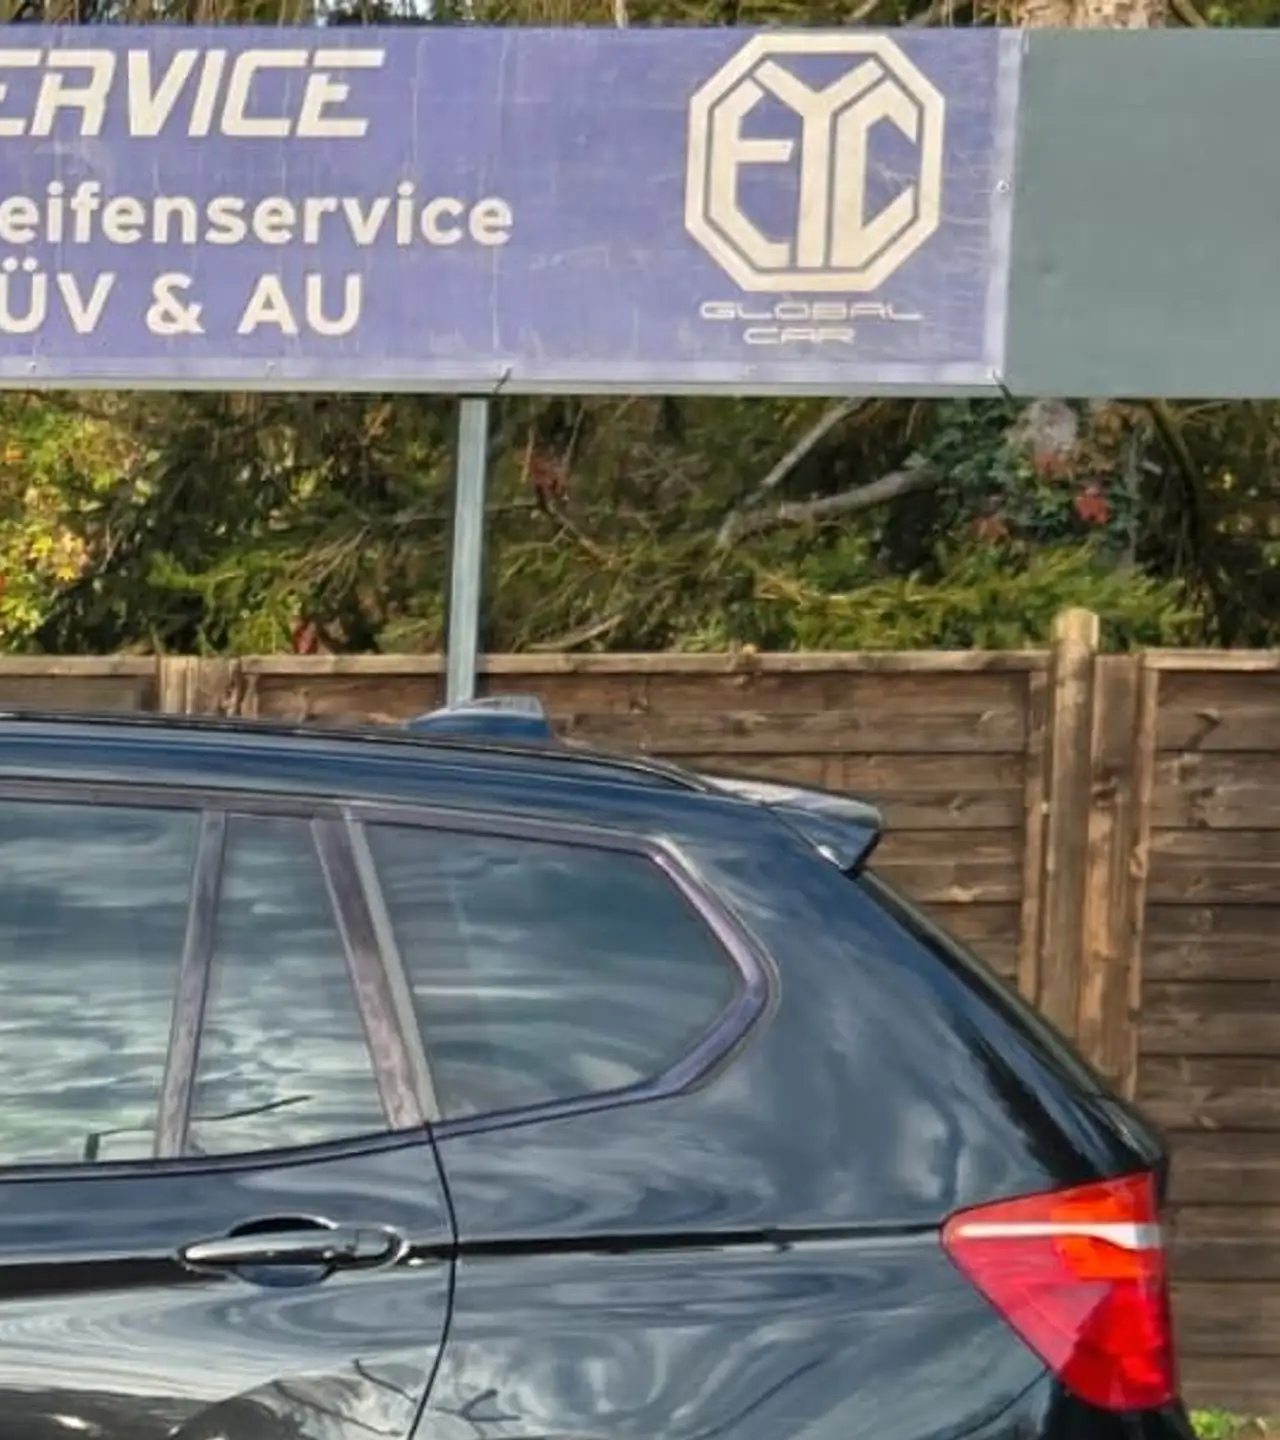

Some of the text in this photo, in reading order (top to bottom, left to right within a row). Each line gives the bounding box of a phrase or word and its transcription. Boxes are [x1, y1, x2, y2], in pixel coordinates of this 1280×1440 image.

[146, 273, 205, 335] &
[237, 274, 361, 336] AU
[699, 300, 924, 321] GLOBAL
[743, 326, 856, 345] CAR
